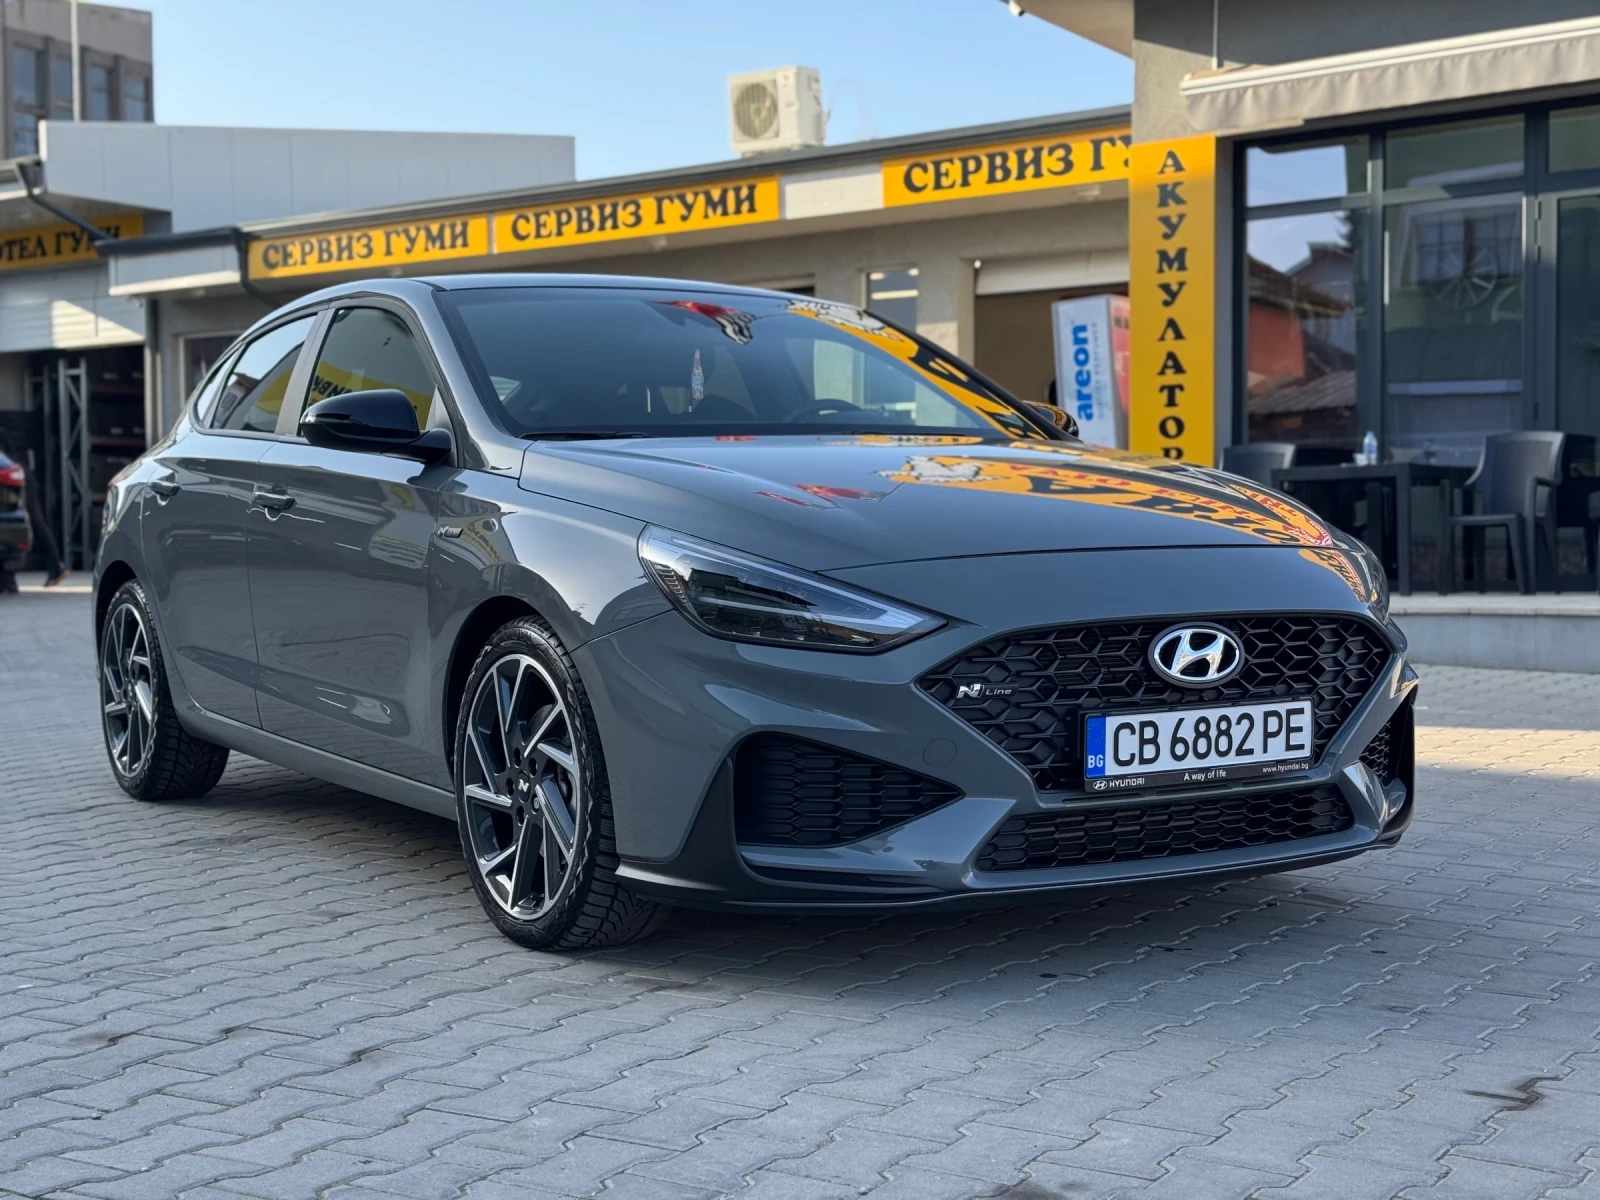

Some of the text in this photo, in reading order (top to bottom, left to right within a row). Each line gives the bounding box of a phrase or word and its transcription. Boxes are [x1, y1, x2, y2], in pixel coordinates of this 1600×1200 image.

[903, 143, 1074, 193] СЕРВИЗ
[511, 183, 758, 241] СЕРВИЗ ГУМИ
[0, 226, 121, 261] ТЕЛ ГУ
[262, 221, 470, 270] СЕРВИЗ ГУМИ
[1071, 323, 1093, 421] areon
[1113, 707, 1305, 767] CB 6882 PE
[1088, 754, 1104, 769] BG
[1184, 772, 1190, 781] A
[1191, 773, 1205, 781] way
[1207, 770, 1215, 778] of
[1261, 762, 1309, 772] www.hyundai.bg
[1109, 778, 1145, 788] HYUNDAI
